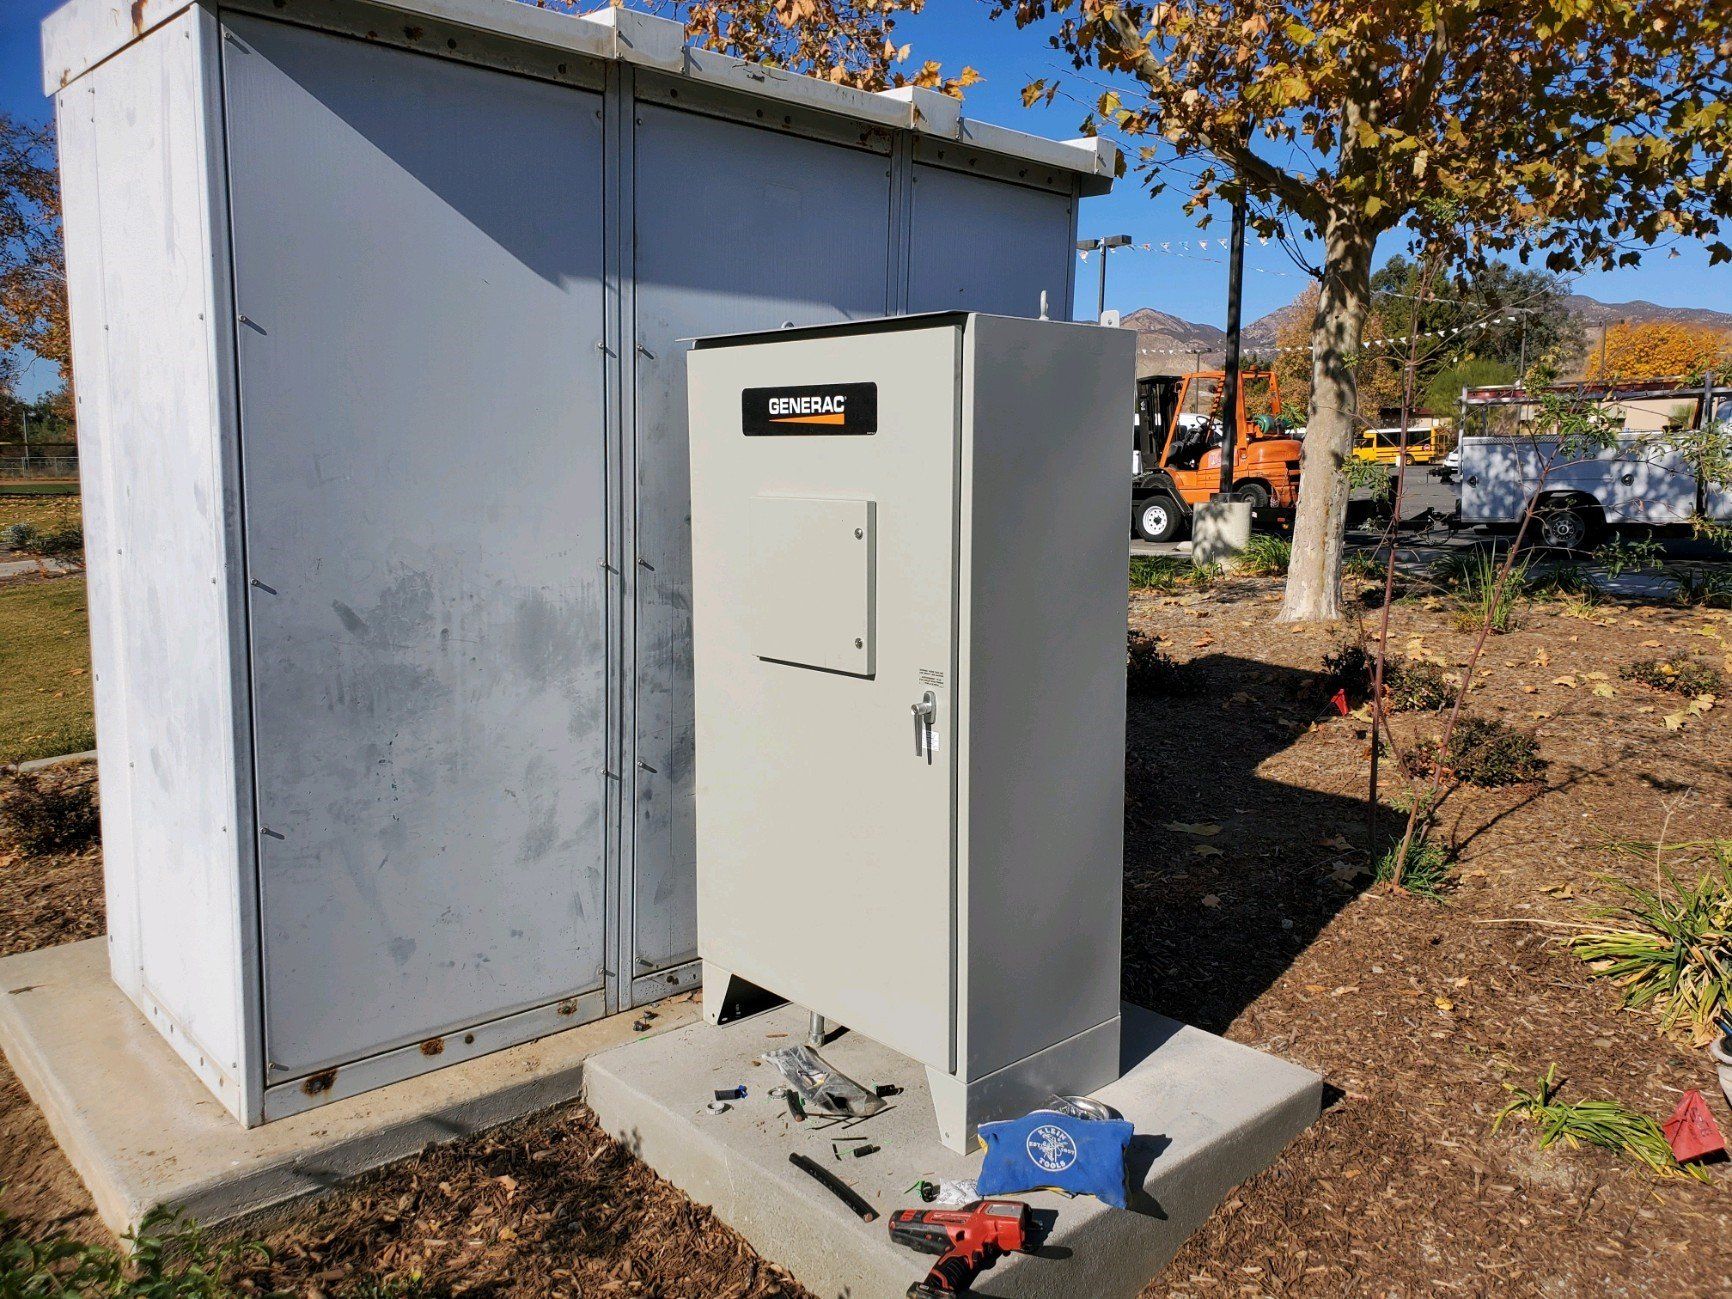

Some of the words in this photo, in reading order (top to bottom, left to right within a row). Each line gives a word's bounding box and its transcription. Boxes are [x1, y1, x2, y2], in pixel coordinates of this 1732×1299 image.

[768, 396, 845, 415] GENERAC
[1037, 1127, 1067, 1141] KLEIN
[1039, 1157, 1066, 1169] TOOLS
